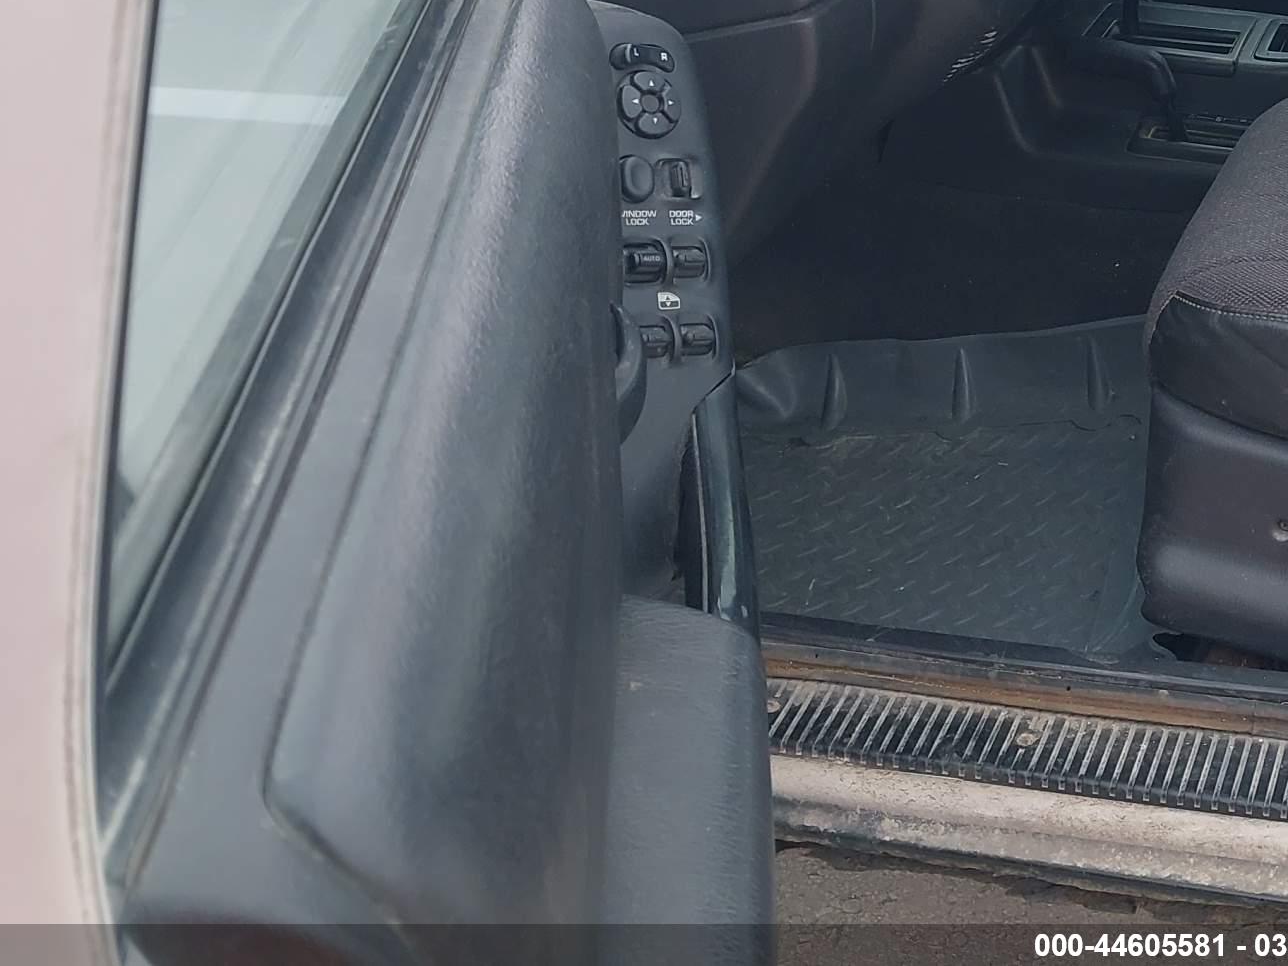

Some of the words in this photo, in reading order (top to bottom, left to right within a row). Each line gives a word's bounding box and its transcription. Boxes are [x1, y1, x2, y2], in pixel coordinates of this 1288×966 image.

[633, 47, 640, 57] L
[660, 52, 668, 61] R
[669, 209, 694, 218] DOOR
[625, 217, 650, 226] LOCK
[670, 217, 694, 226] LOCK
